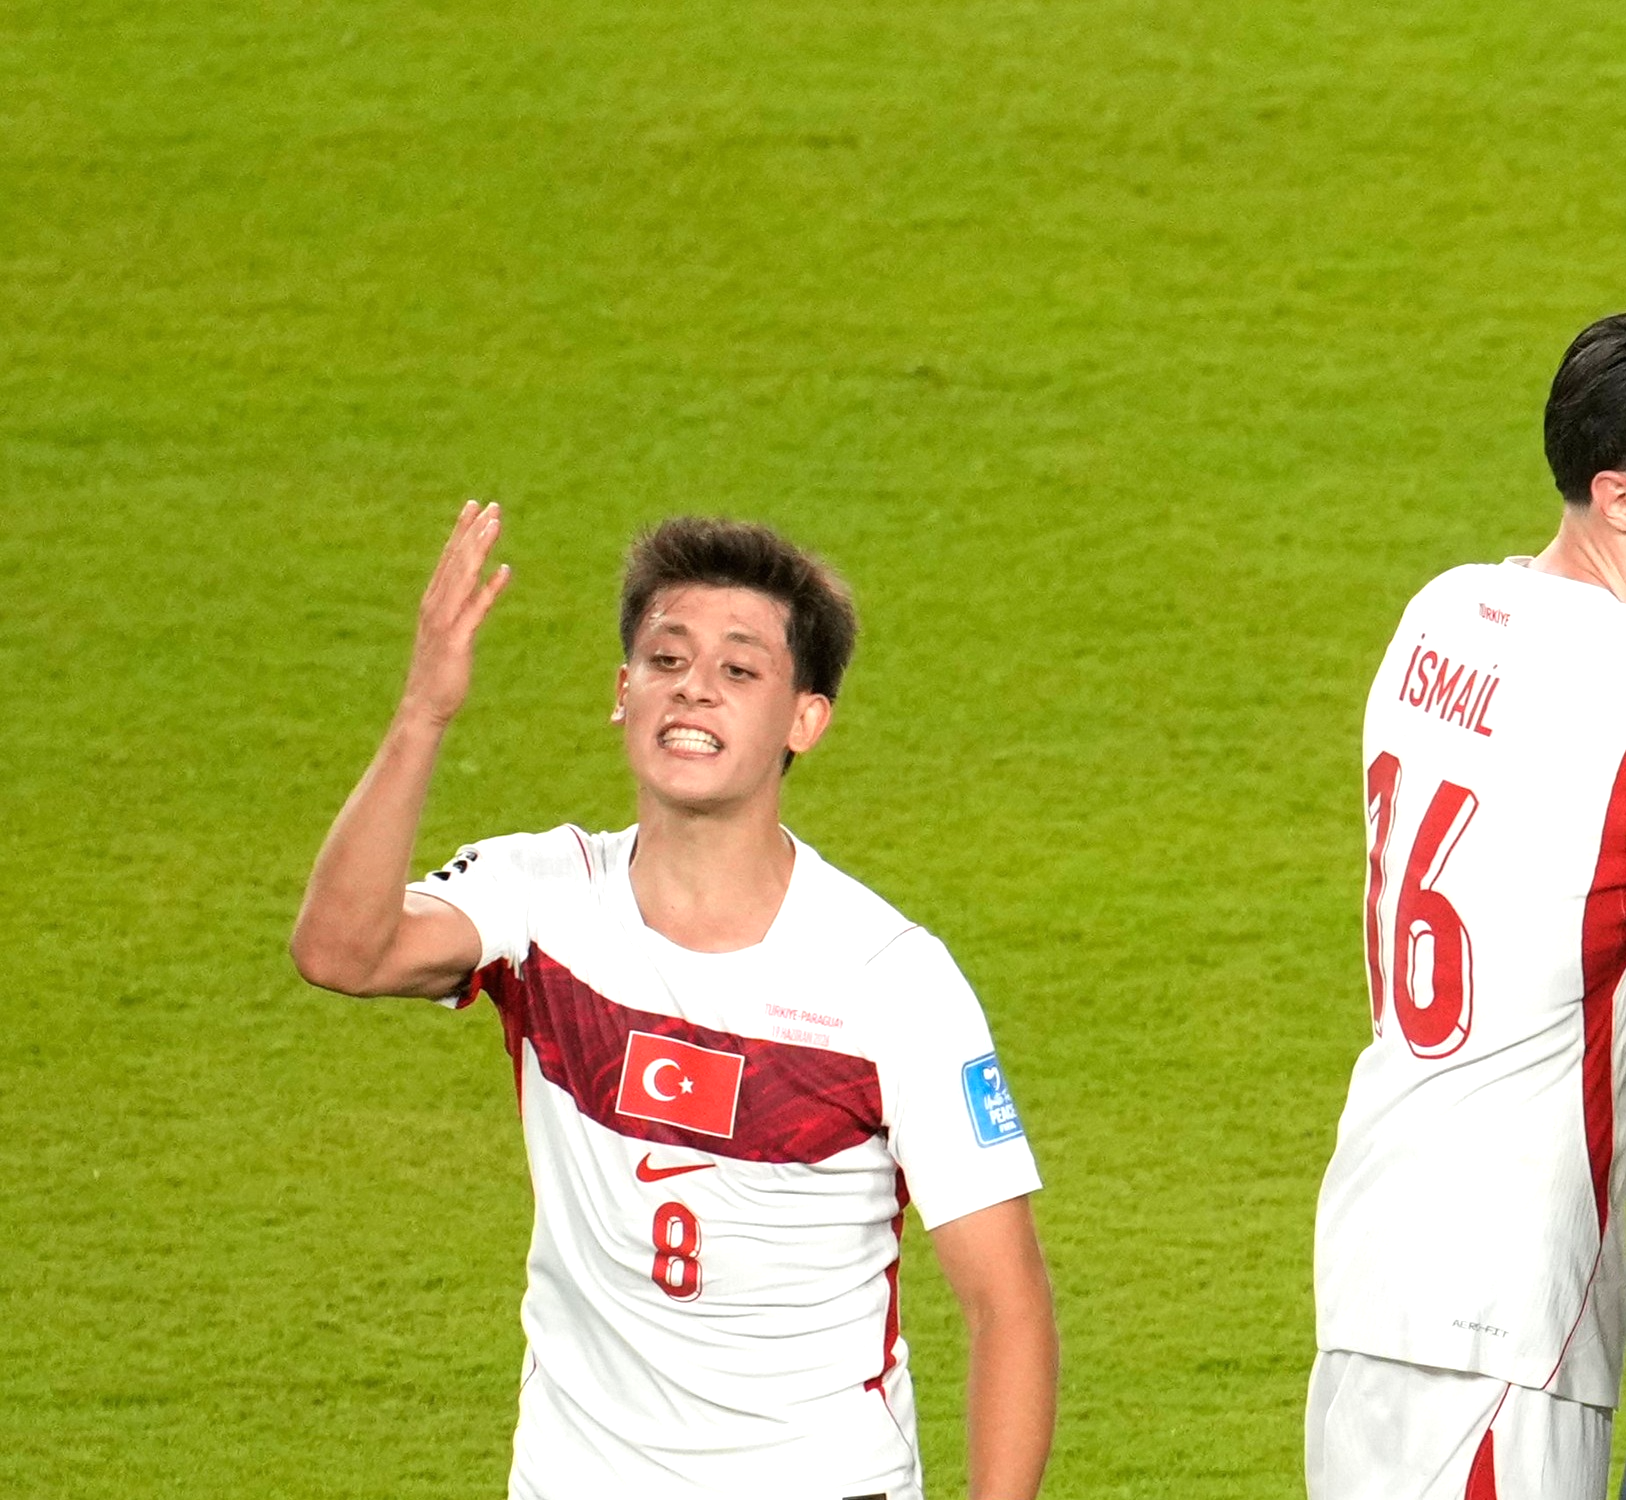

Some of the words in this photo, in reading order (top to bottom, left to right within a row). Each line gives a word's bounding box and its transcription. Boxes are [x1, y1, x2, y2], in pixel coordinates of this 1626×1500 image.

[1399, 633, 1500, 737] İSMAİL
[1367, 750, 1479, 1059] 16
[651, 1201, 703, 1303] 8
